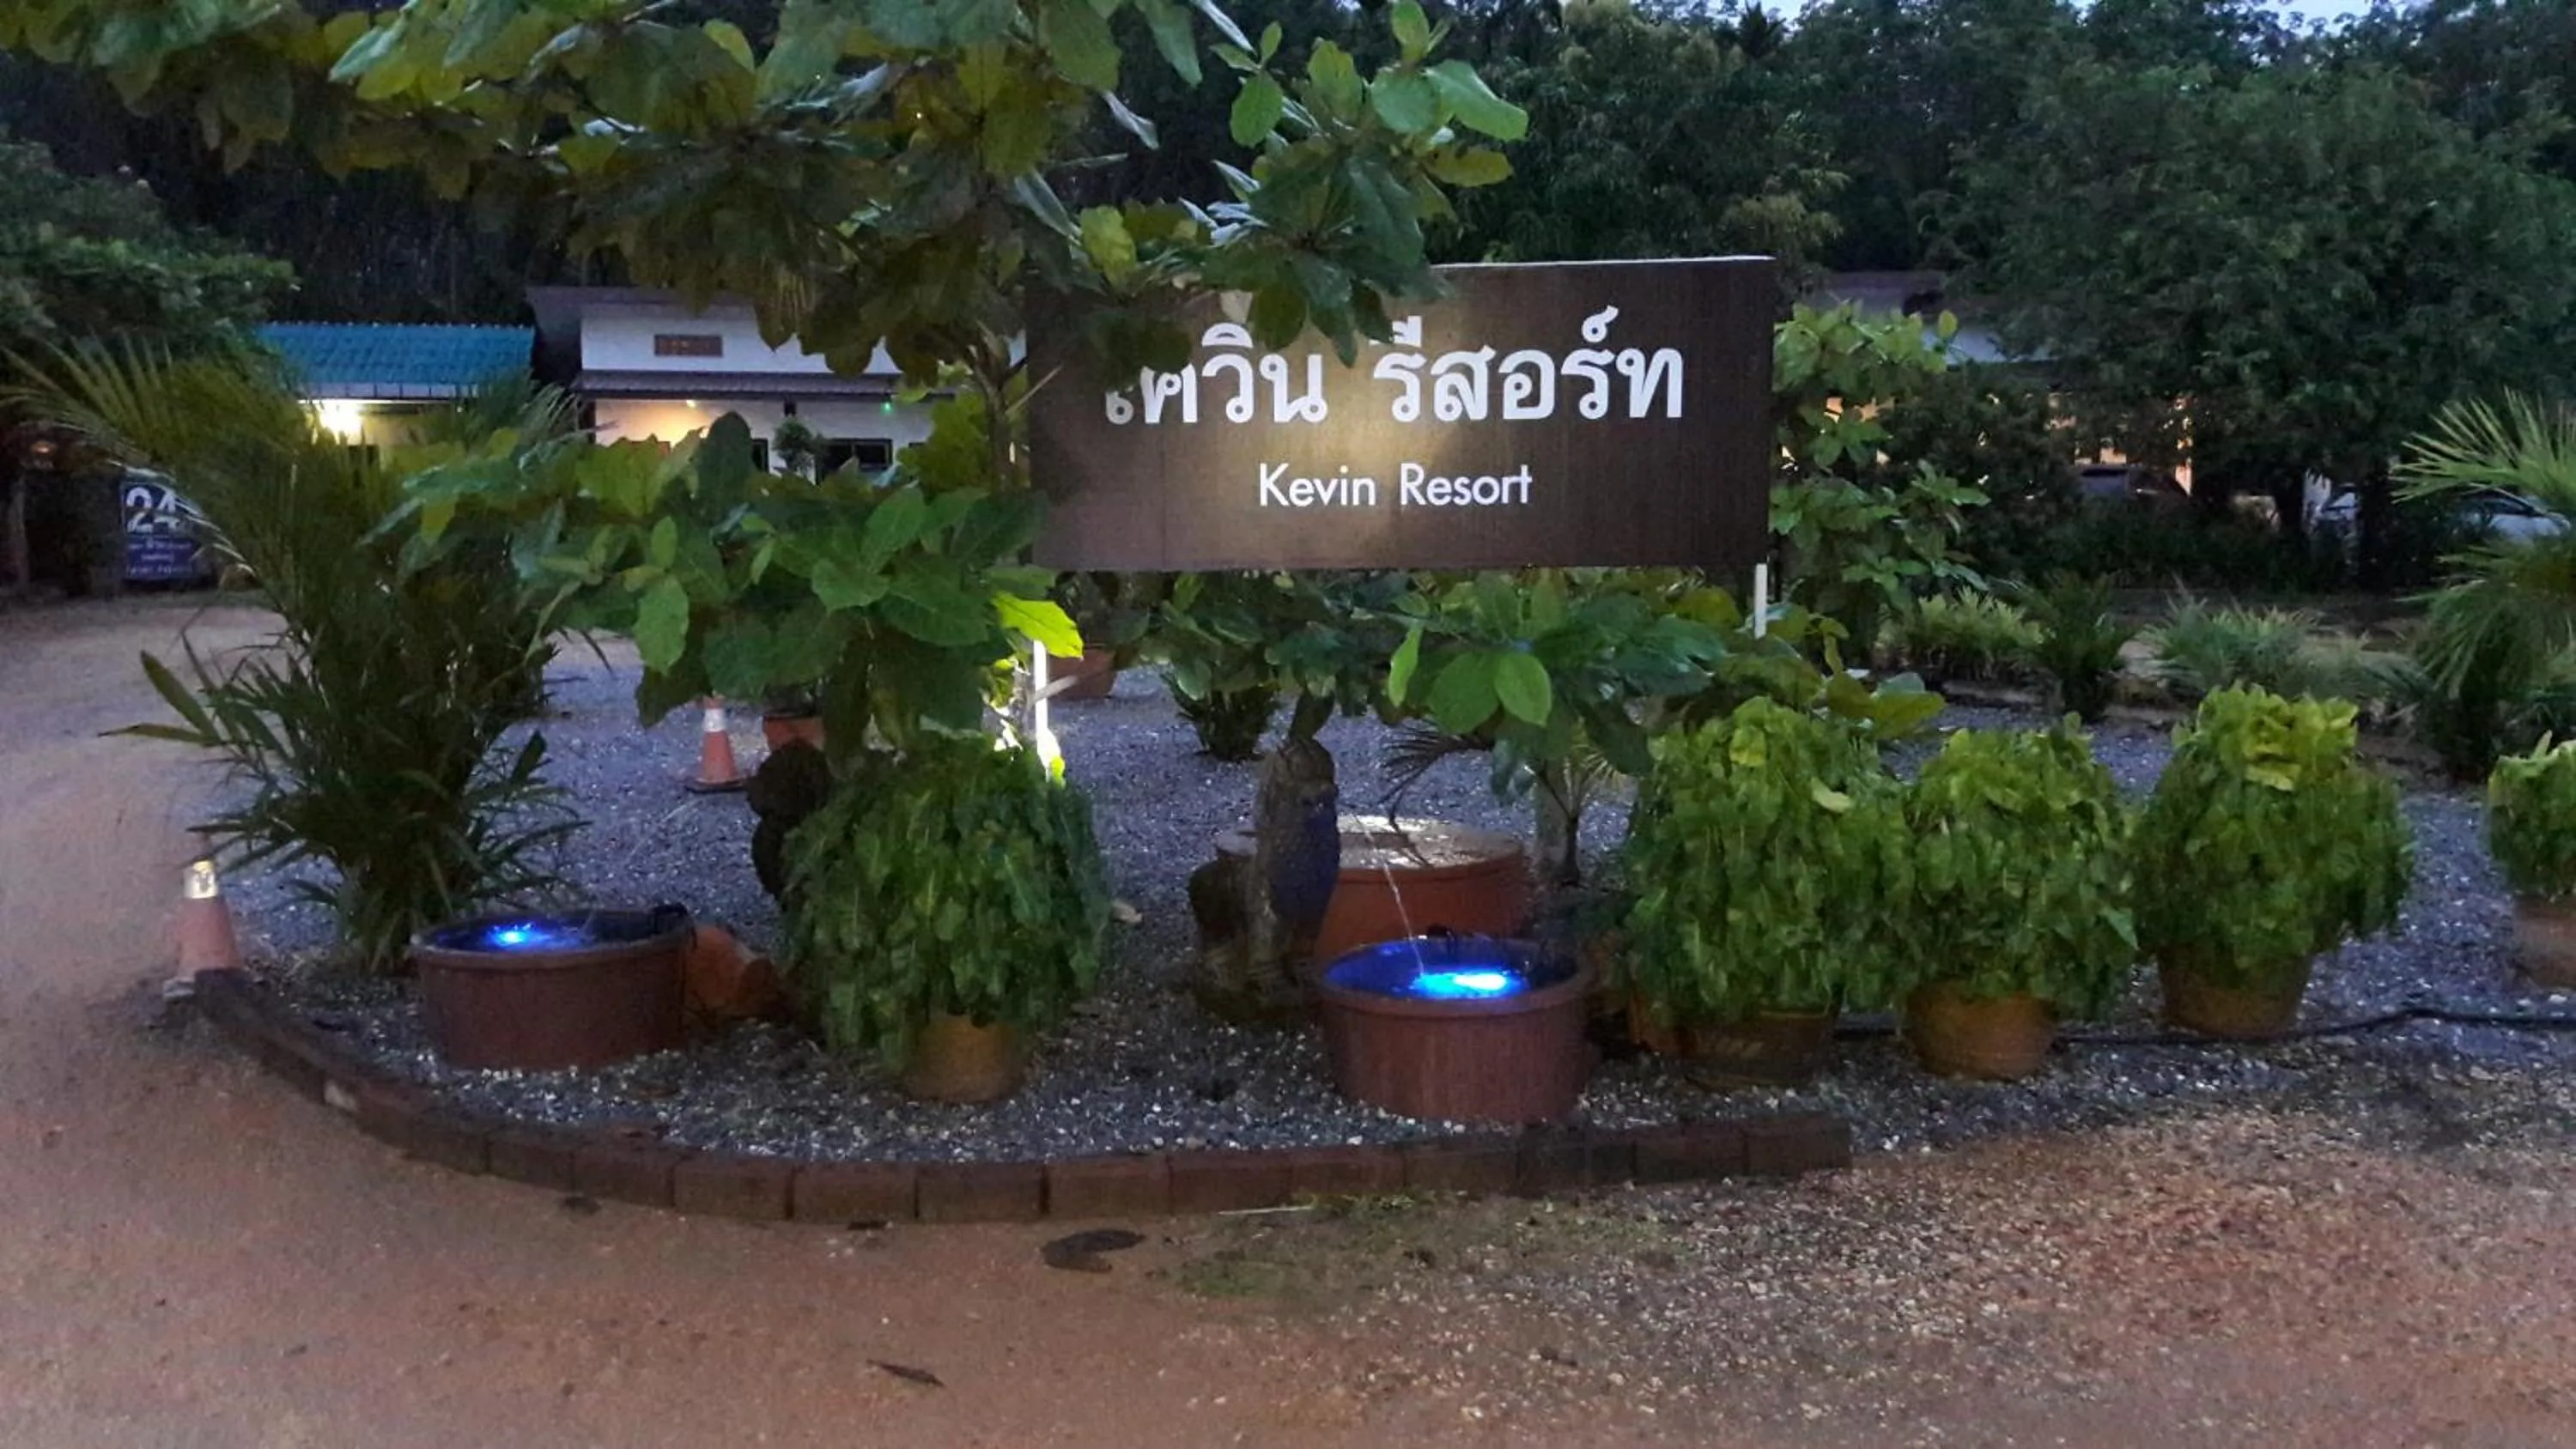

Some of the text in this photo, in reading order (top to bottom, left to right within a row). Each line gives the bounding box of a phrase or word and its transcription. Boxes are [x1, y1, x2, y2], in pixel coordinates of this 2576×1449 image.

[1370, 306, 1683, 422] รีสอร์ท
[1260, 463, 1533, 506] Kevin Resort
[126, 487, 180, 533] 24
